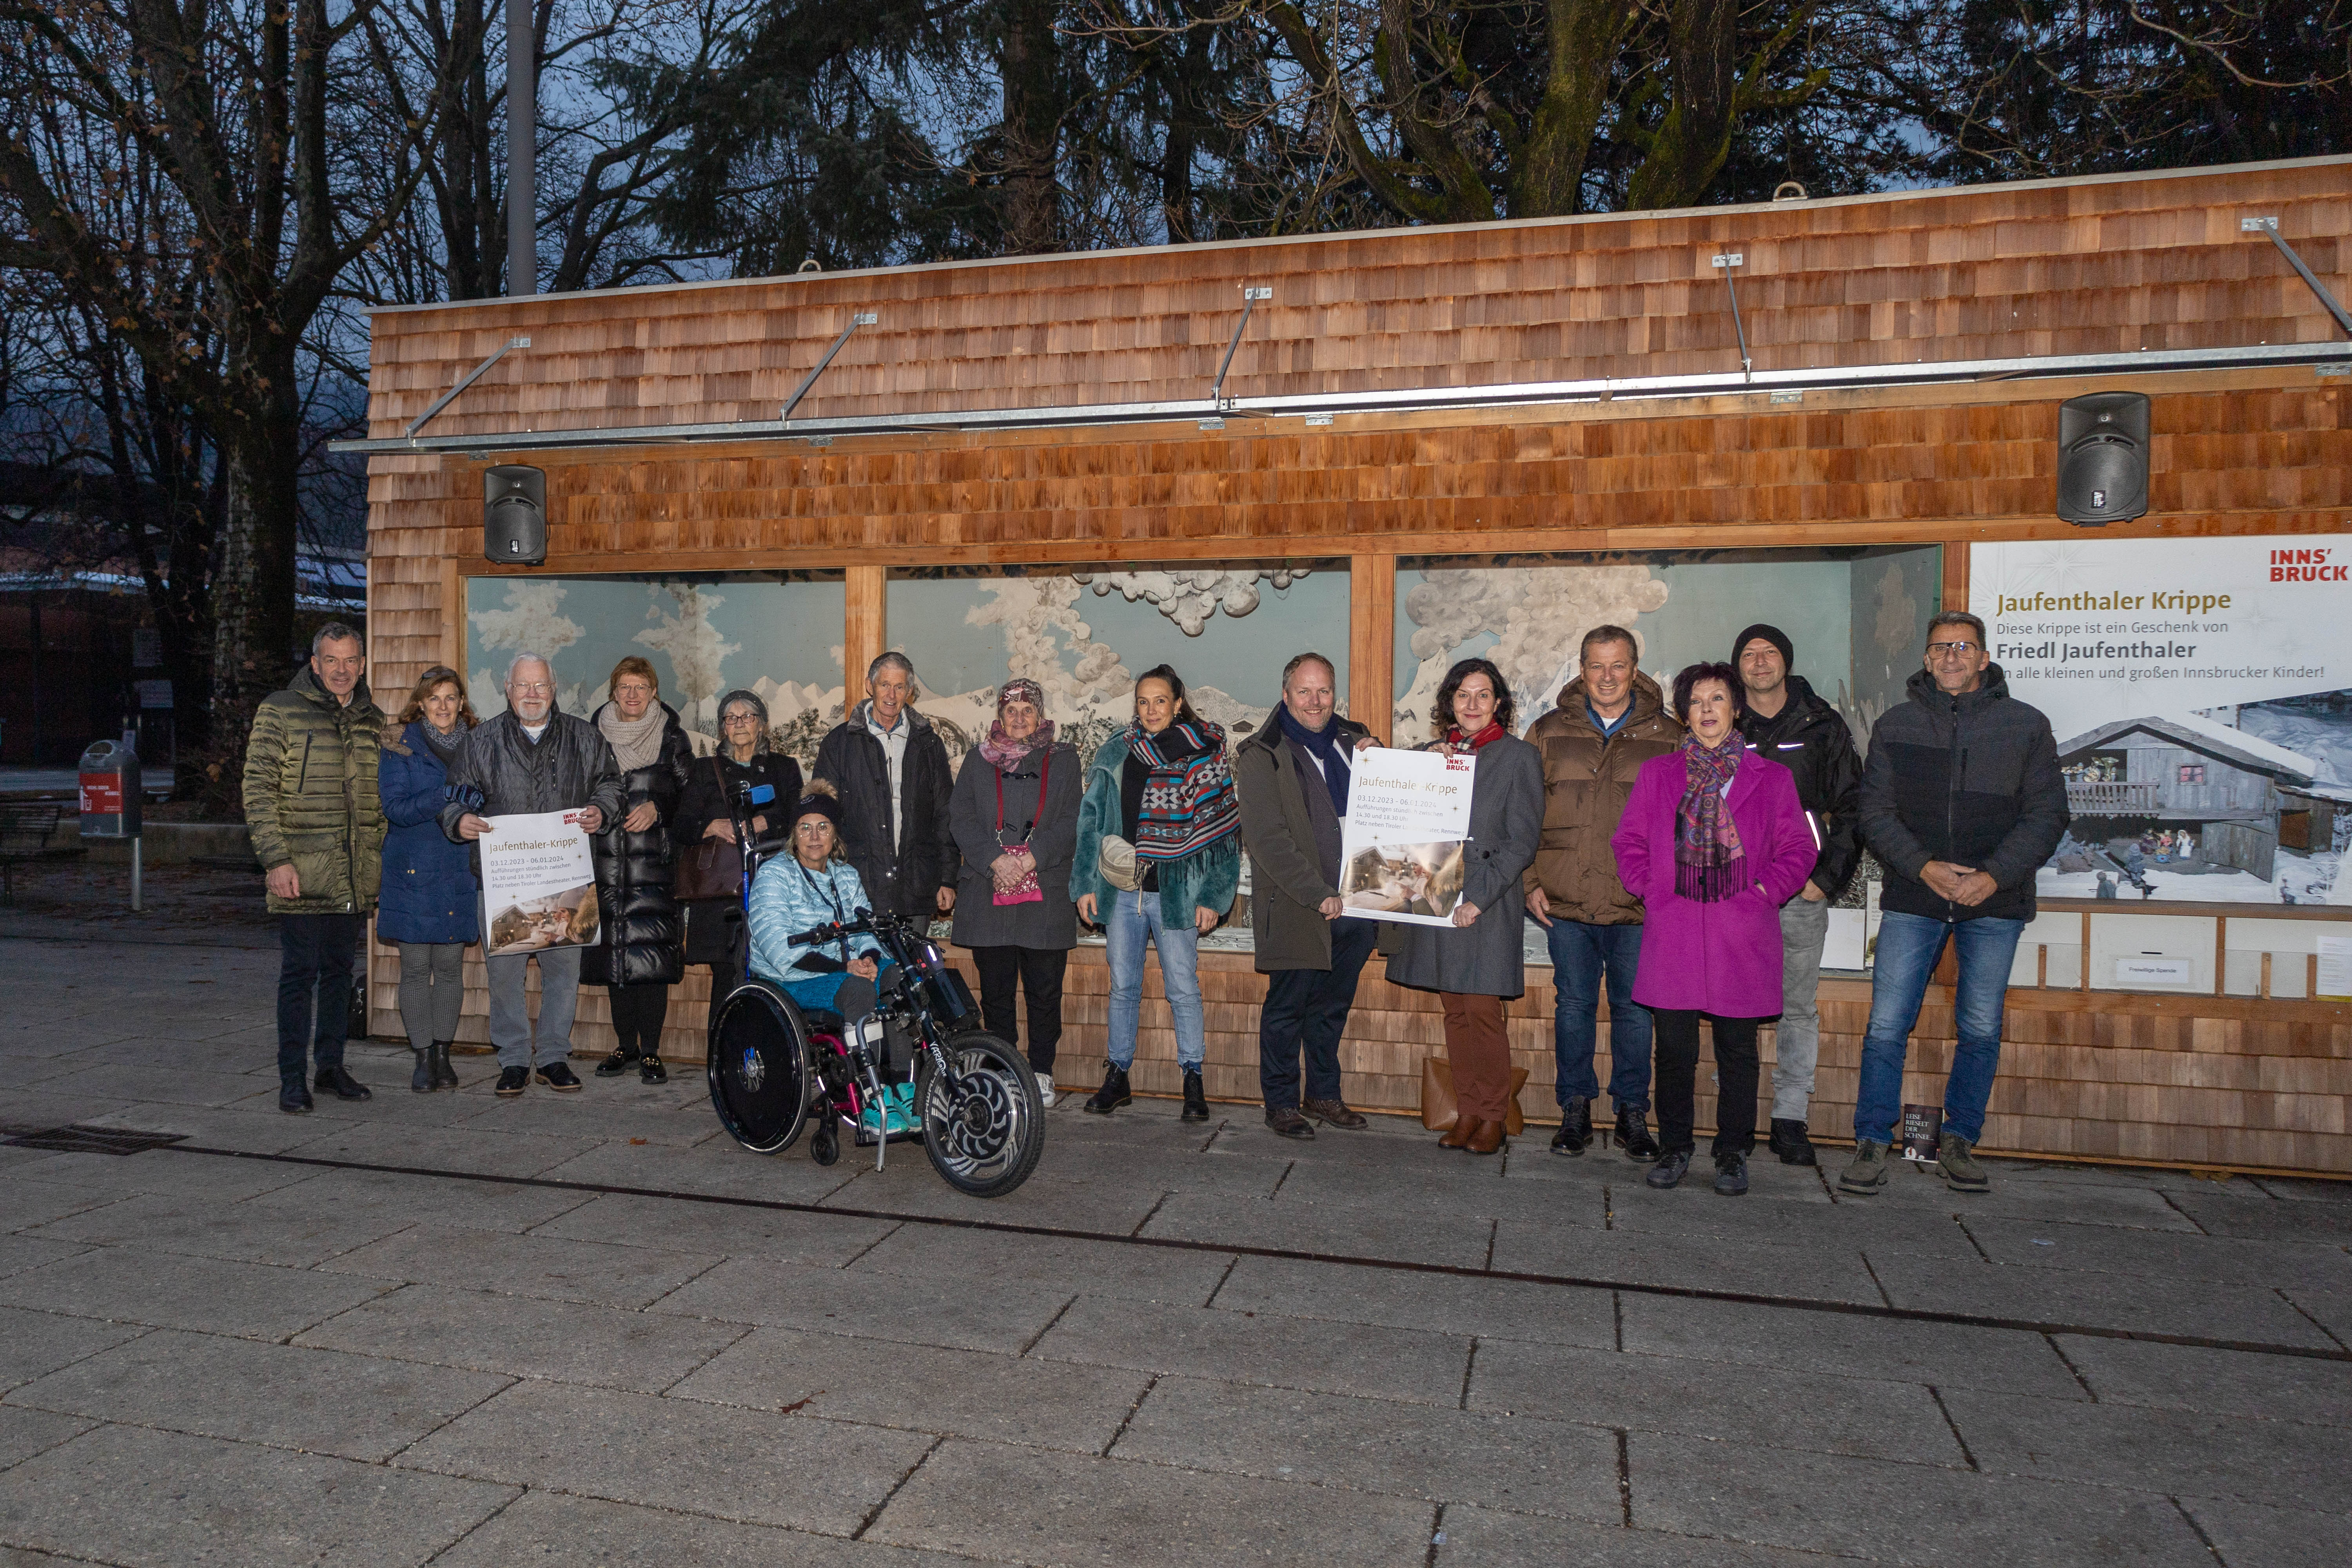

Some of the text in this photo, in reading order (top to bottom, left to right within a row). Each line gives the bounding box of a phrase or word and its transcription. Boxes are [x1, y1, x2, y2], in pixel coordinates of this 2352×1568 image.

[2270, 548, 2332, 565] INNS'
[2269, 566, 2348, 582] BRUCK
[1996, 590, 2231, 617] Jaufenthaler Krippe
[1997, 621, 2229, 637] Diese Krippe ist ein Geschenk von
[1997, 641, 2196, 663] Friedl Jaufenthaler
[2016, 667, 2040, 679] alle
[2045, 667, 2093, 679] kleinen
[2099, 666, 2125, 679] und
[2129, 666, 2178, 682] großen
[2183, 666, 2269, 678] Innsbrucker
[2273, 665, 2324, 678] Kinder!
[1359, 776, 1457, 796] Jaufenthale-Krppe
[1357, 795, 1394, 804] 03.12.2023
[564, 817, 582, 825] BRUC
[1441, 828, 1465, 837] Rennweg
[490, 837, 578, 854] Jaufenthaler-Krippe
[530, 855, 564, 864] 06.01.2024
[925, 1067, 940, 1131] SCHWALB
